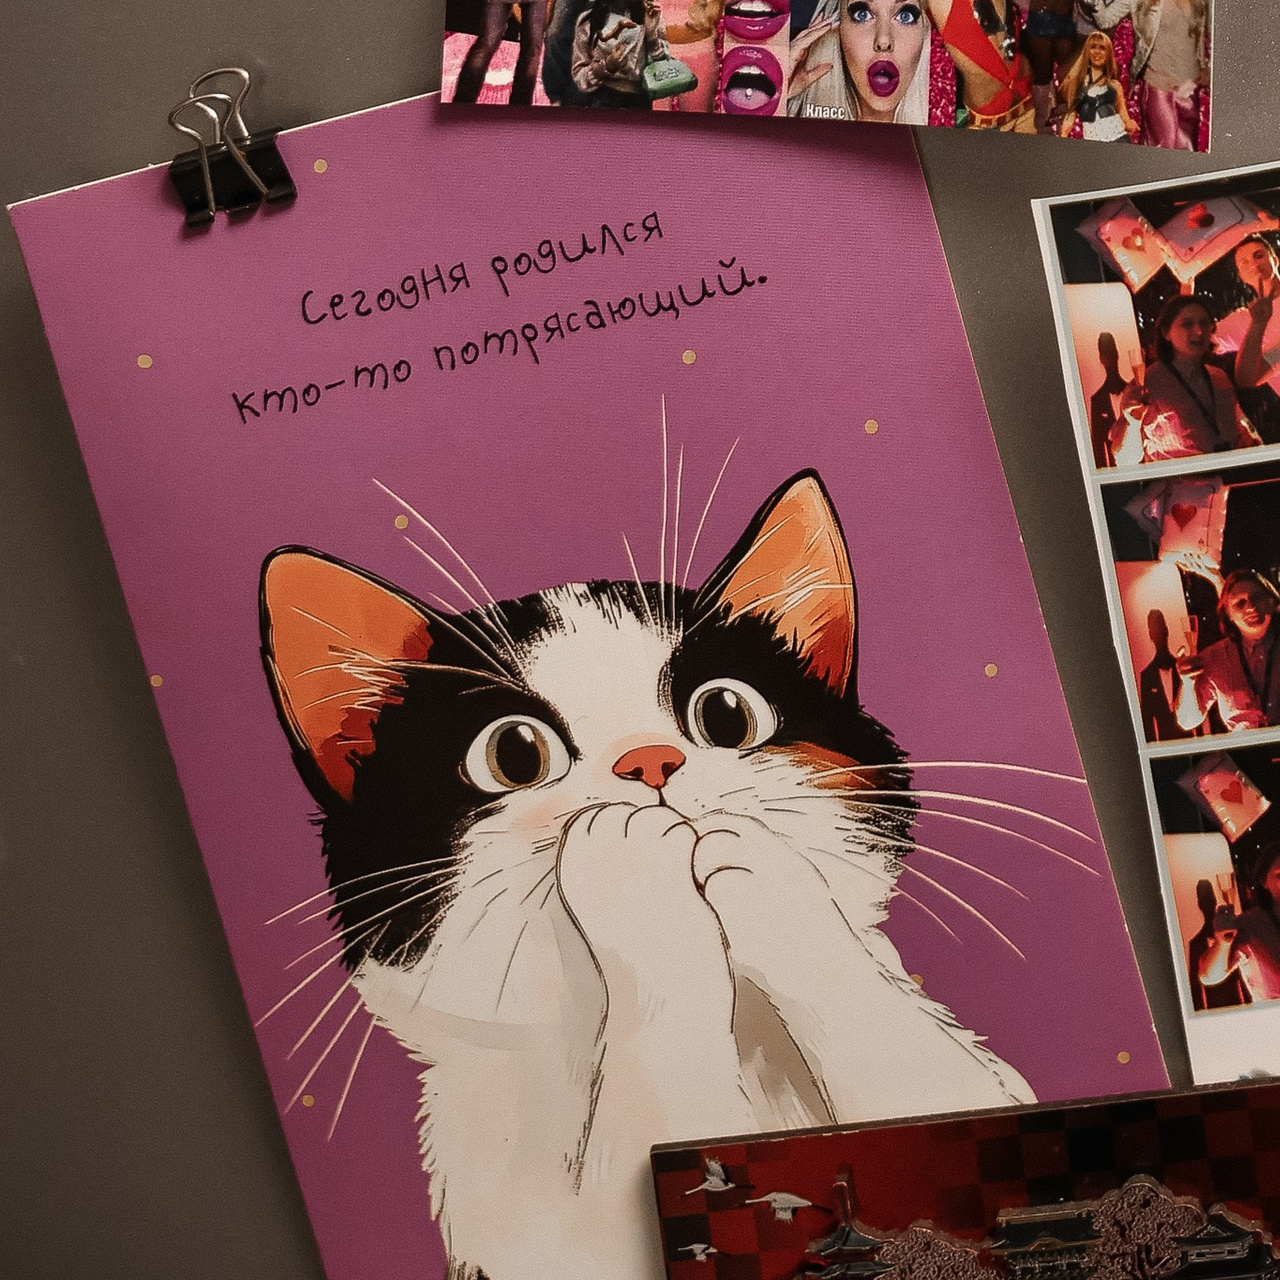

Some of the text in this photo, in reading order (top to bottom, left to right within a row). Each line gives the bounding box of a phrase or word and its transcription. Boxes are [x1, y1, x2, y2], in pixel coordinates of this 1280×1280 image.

[806, 103, 846, 119] Класс
[301, 210, 665, 326] Сегодня родился
[231, 255, 770, 425] кто-то потрясающий.
